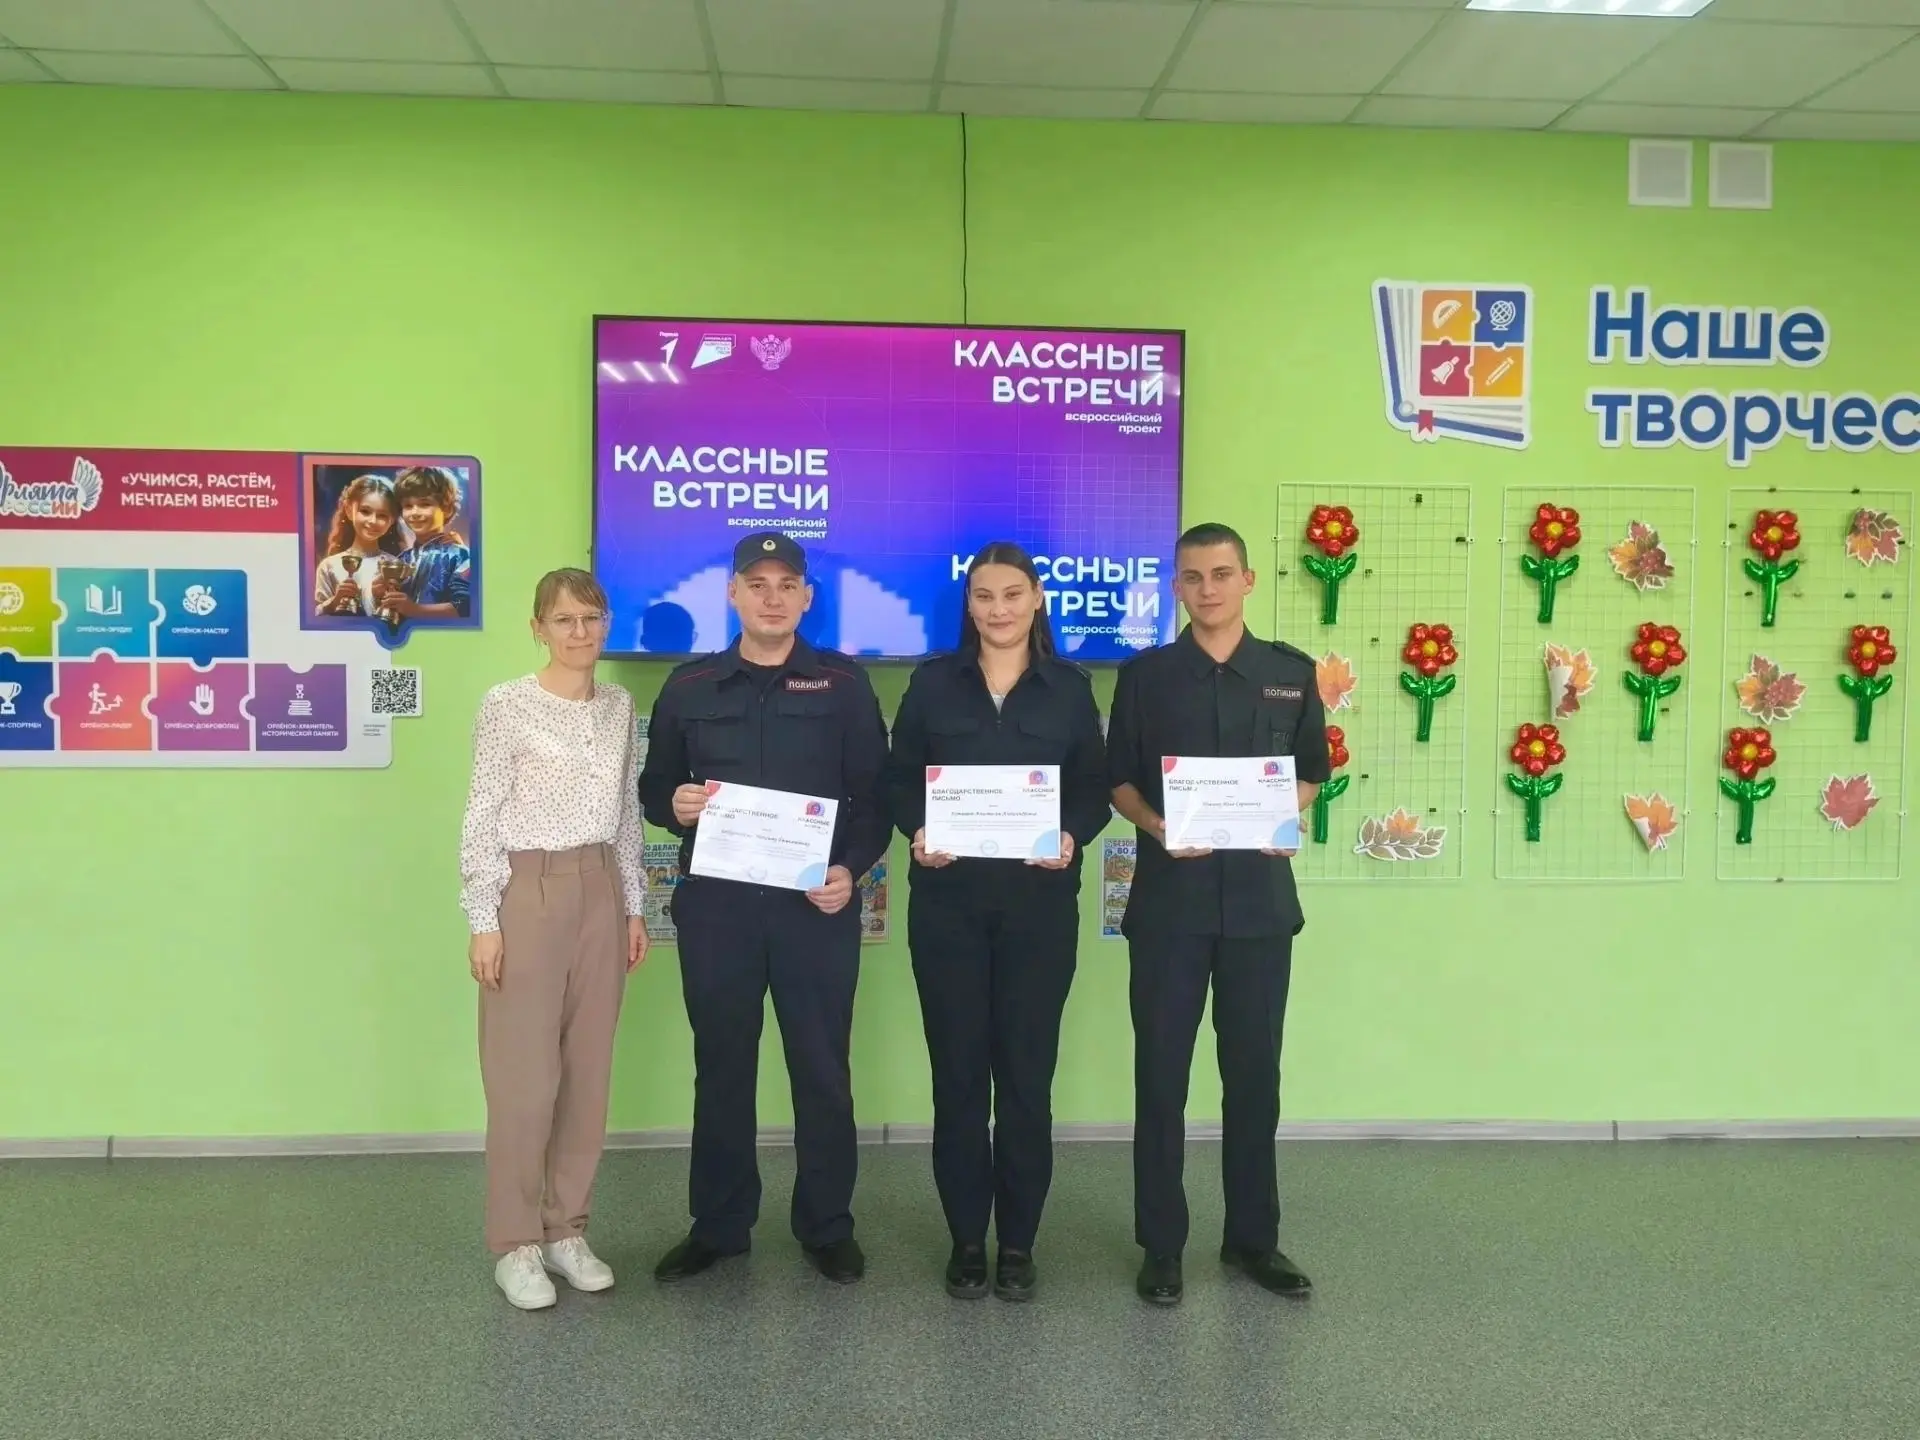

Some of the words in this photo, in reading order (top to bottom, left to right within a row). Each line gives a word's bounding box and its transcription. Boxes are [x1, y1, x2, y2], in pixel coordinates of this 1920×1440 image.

[1594, 291, 1825, 362] Наше
[954, 339, 1164, 371] КЛАССНЫЕ
[992, 375, 1164, 406] ВСТРЕЧИ
[1065, 411, 1163, 424] всероссийский
[1591, 393, 1920, 461] творчес
[1118, 424, 1163, 434] проект
[614, 444, 829, 476] КЛАССНЫЕ
[0, 473, 79, 507] рлята
[121, 472, 203, 490] «УЧИМСЯ,
[207, 473, 276, 491] РАСТЁМ,
[120, 492, 197, 507] МЕЧТАЕМ
[201, 493, 279, 509] ВМЕСТЕ!»
[653, 480, 829, 511] ВСТРЕЧИ
[727, 516, 827, 529] всероссийский
[782, 529, 827, 540] проект
[951, 554, 1160, 584] КССНЫЕ
[1043, 590, 1160, 617] ТРЕЧИ
[1061, 623, 1158, 635] всероссийский
[1114, 636, 1158, 646] проект
[788, 679, 829, 689] ПОЛИЦИЯ
[1264, 688, 1302, 698] ПОЛИЦИЯ
